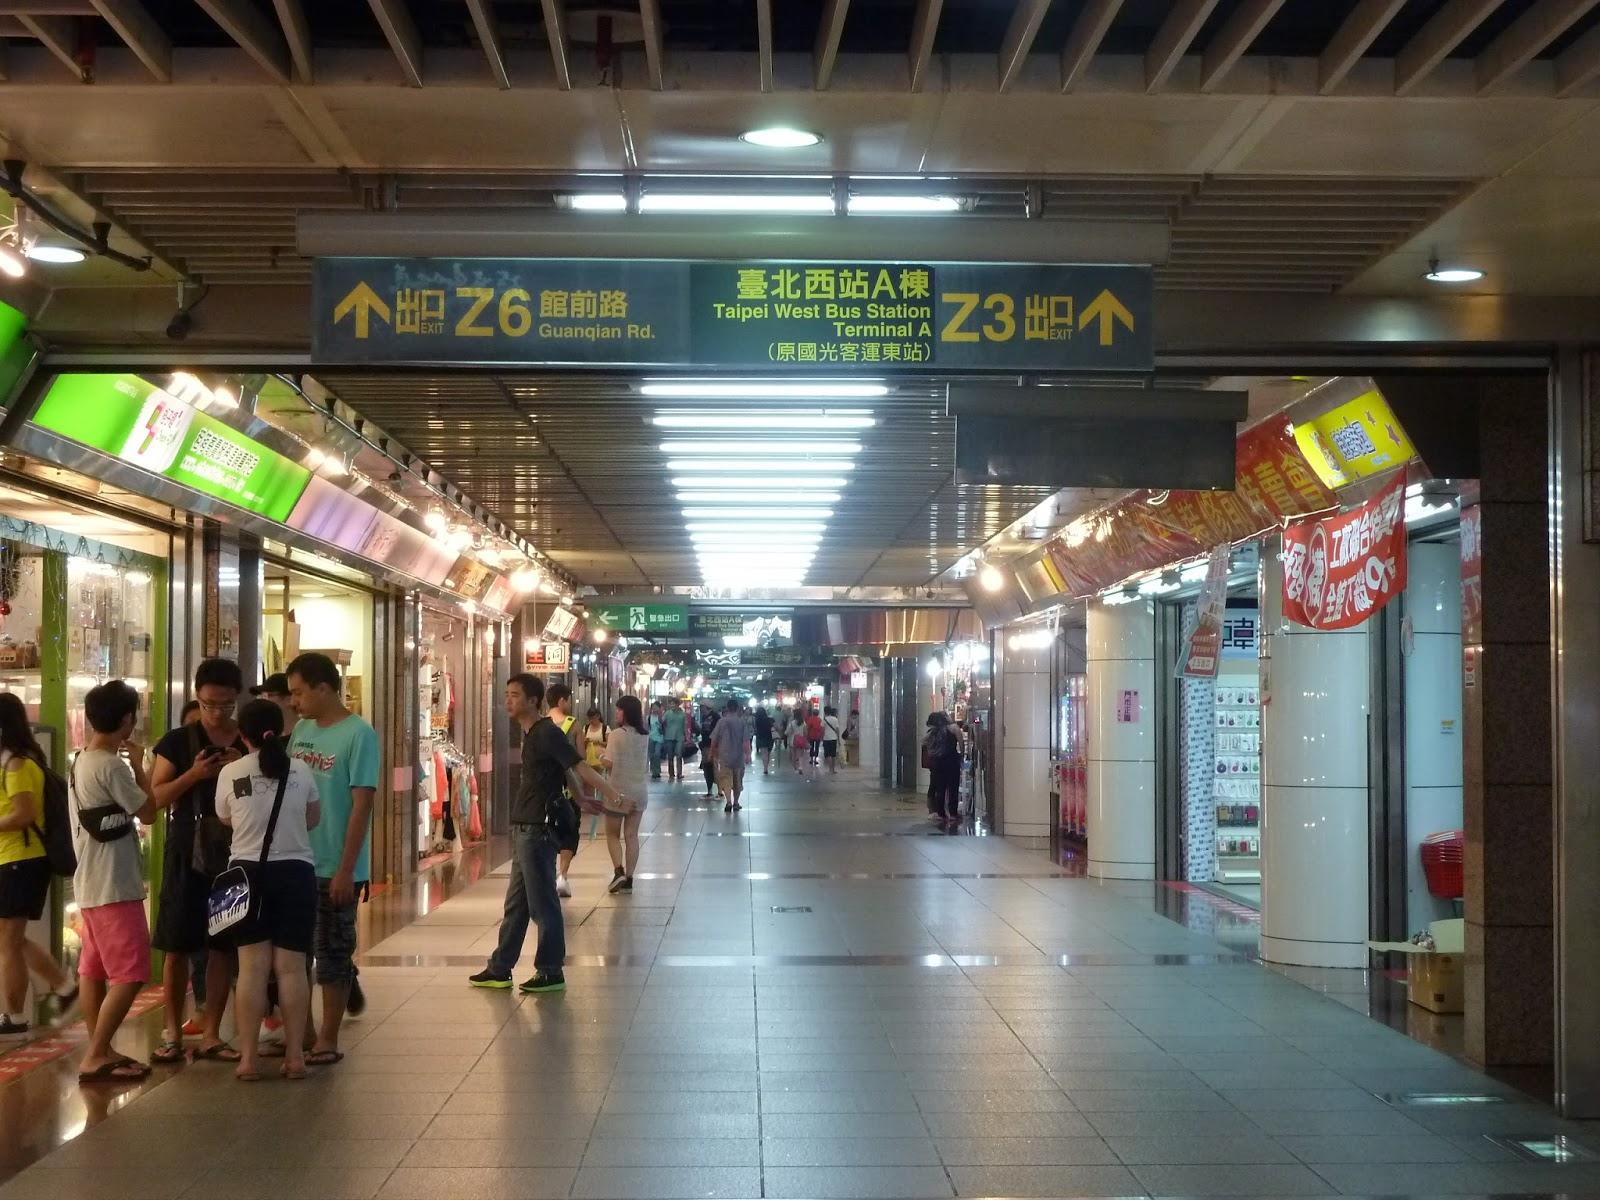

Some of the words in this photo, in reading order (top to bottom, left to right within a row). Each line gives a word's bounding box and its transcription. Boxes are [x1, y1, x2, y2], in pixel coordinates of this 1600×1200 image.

[737, 268, 931, 300] 臺北西站A棟
[396, 289, 445, 335] 出口
[455, 286, 533, 338] Z6
[539, 290, 629, 319] 館前路
[713, 303, 769, 319] Taipei
[773, 303, 820, 318] West
[824, 303, 862, 318] Bus
[866, 303, 931, 318] Station
[940, 292, 1016, 343] Z3
[1025, 293, 1074, 341] 出口
[420, 322, 444, 335] EXIT
[538, 323, 622, 341] Guanqian
[626, 323, 656, 339] Rd.
[833, 321, 913, 338] Terminal
[918, 322, 932, 338] A
[1049, 328, 1073, 341] EXIT
